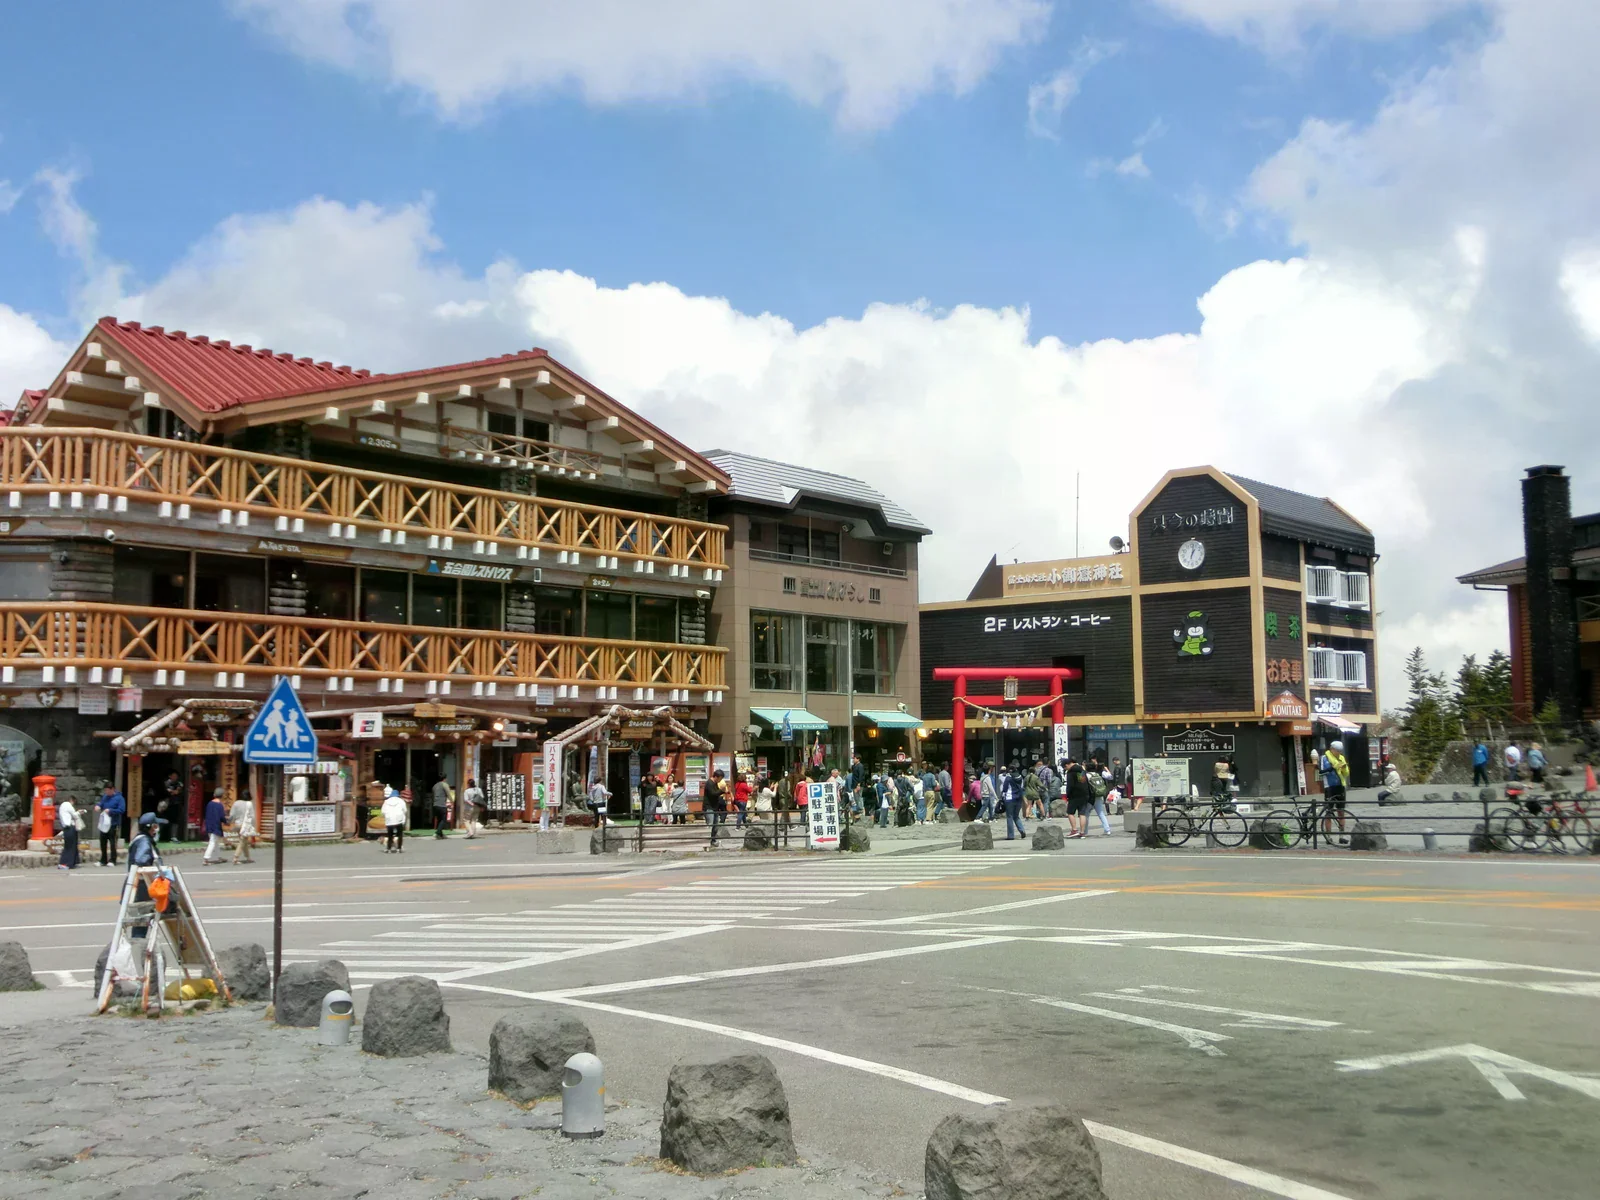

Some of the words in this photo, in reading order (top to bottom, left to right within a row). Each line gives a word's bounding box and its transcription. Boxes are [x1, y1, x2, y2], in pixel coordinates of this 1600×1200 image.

[984, 617, 1006, 632] 2F
[1013, 613, 1111, 630] レストラン・コーヒー
[1267, 658, 1302, 684] お食事
[1272, 705, 1302, 716] KOMITAKE
[548, 745, 557, 803] バス進入禁止
[811, 799, 824, 836] 駐車場
[824, 783, 836, 835] 普通車専用
